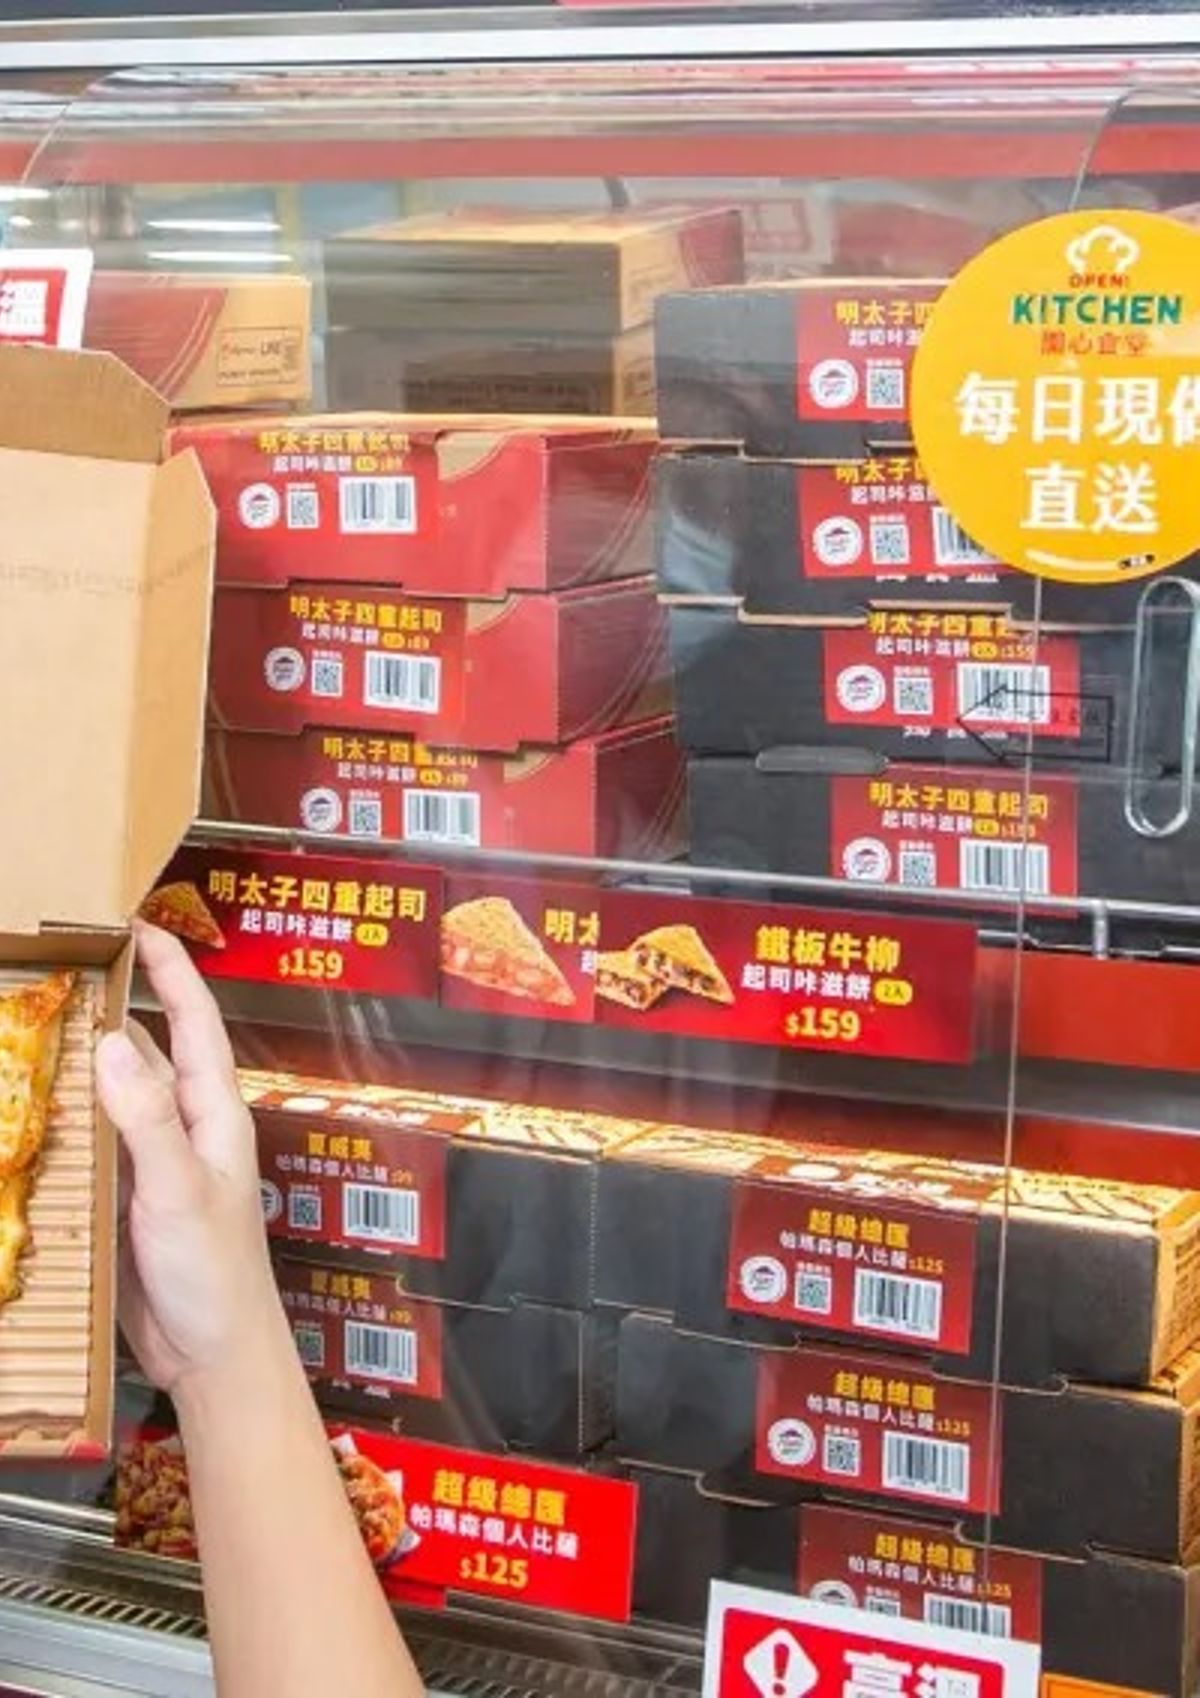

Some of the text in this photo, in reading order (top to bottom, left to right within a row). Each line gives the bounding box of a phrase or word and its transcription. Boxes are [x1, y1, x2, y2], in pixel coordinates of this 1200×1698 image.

[1012, 294, 1182, 325] KITCHEN
[1019, 461, 1160, 534] 直送
[290, 595, 443, 633] 明太子四重起司
[869, 782, 1049, 821] 明太子四重起司
[208, 868, 427, 923] 明太子四重起司
[240, 908, 354, 943] 起司咔滋餅
[278, 946, 344, 980] $159
[755, 925, 902, 973] 鐵板牛柳
[741, 962, 872, 1001] 起司咔滋餅
[785, 1007, 861, 1041] $159
[808, 1208, 910, 1249] 超級總匯
[833, 1371, 937, 1412] 超級總匯
[433, 1468, 566, 1527] 超級總匯
[409, 1502, 580, 1561] 帕瑪森個人比薩
[458, 1551, 529, 1590] $125
[875, 1532, 976, 1574] 超級總匯
